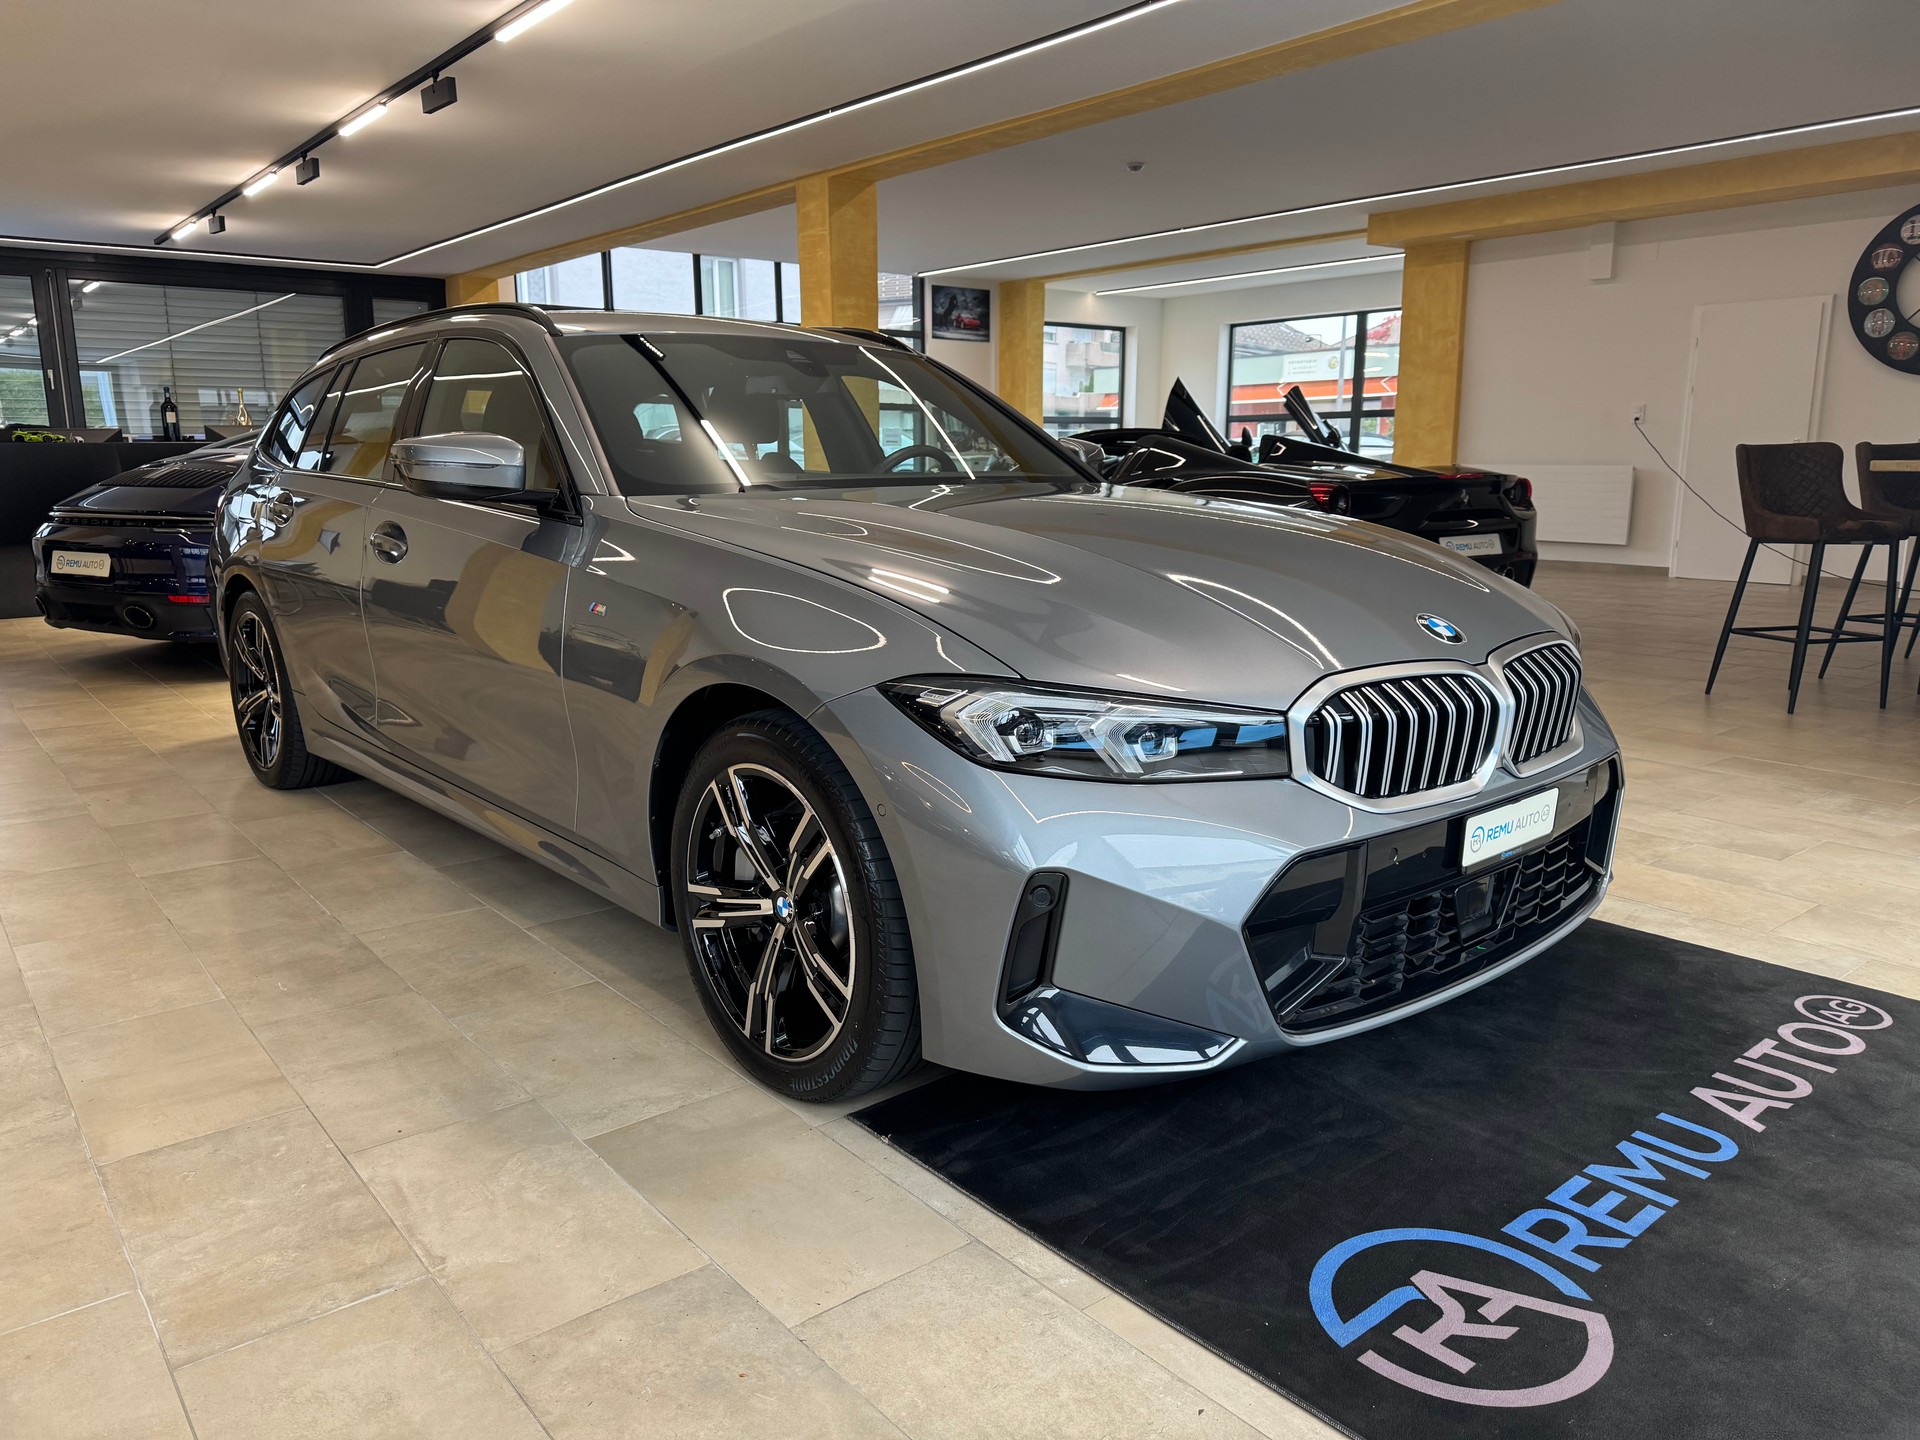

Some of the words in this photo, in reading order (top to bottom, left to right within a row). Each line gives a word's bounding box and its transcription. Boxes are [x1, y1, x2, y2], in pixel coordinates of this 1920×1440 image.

[1455, 542, 1472, 551] REMU
[1473, 541, 1488, 550] AUTO
[65, 559, 82, 568] REMU
[82, 560, 99, 569] AUTO
[1486, 820, 1514, 842] REMU
[1514, 811, 1540, 832] AUTO
[1500, 1112, 1739, 1273] REMU
[1689, 1022, 1867, 1134] AUTO
[1818, 1000, 1867, 1025] AG
